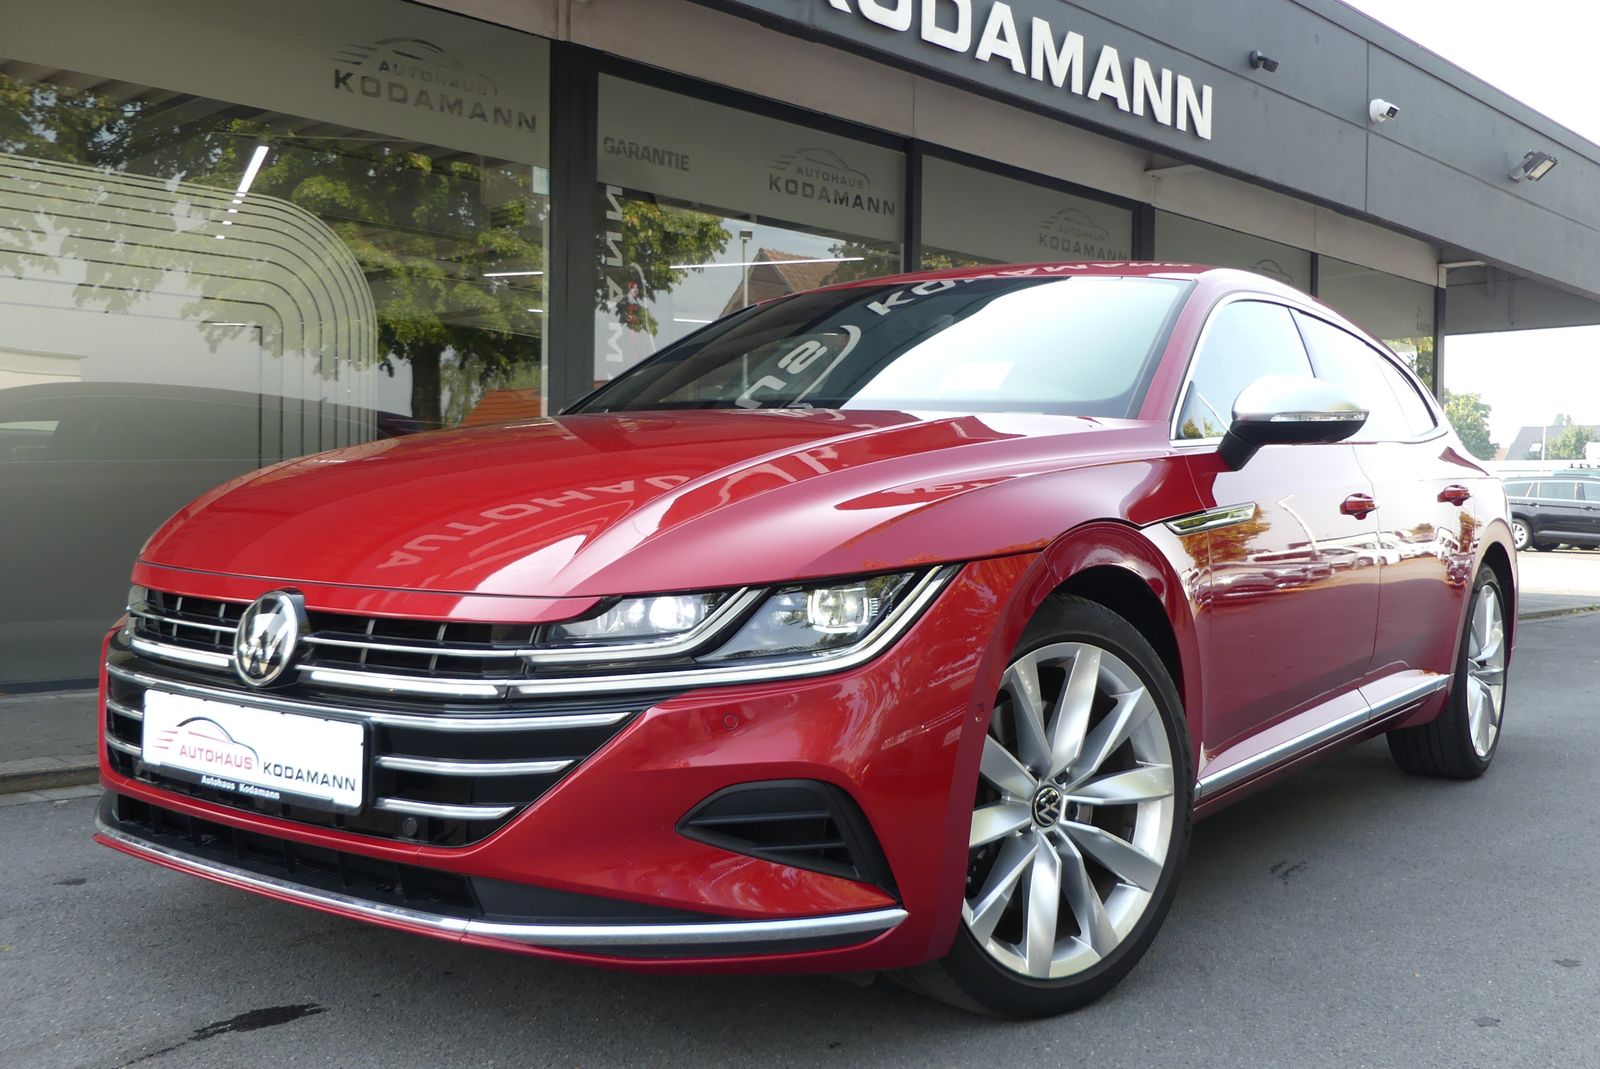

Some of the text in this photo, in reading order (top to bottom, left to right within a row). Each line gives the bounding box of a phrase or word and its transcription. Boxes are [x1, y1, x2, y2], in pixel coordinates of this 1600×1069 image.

[827, 0, 1213, 140] DAMANN
[334, 69, 537, 132] KODAMANN
[603, 136, 690, 172] GARANTIE
[769, 174, 896, 216] KODAMANN
[796, 165, 865, 190] AUTOHAUS
[179, 745, 356, 792] AUTOHAUS KODAMANN
[201, 774, 280, 800] Autohaus Kodamann
